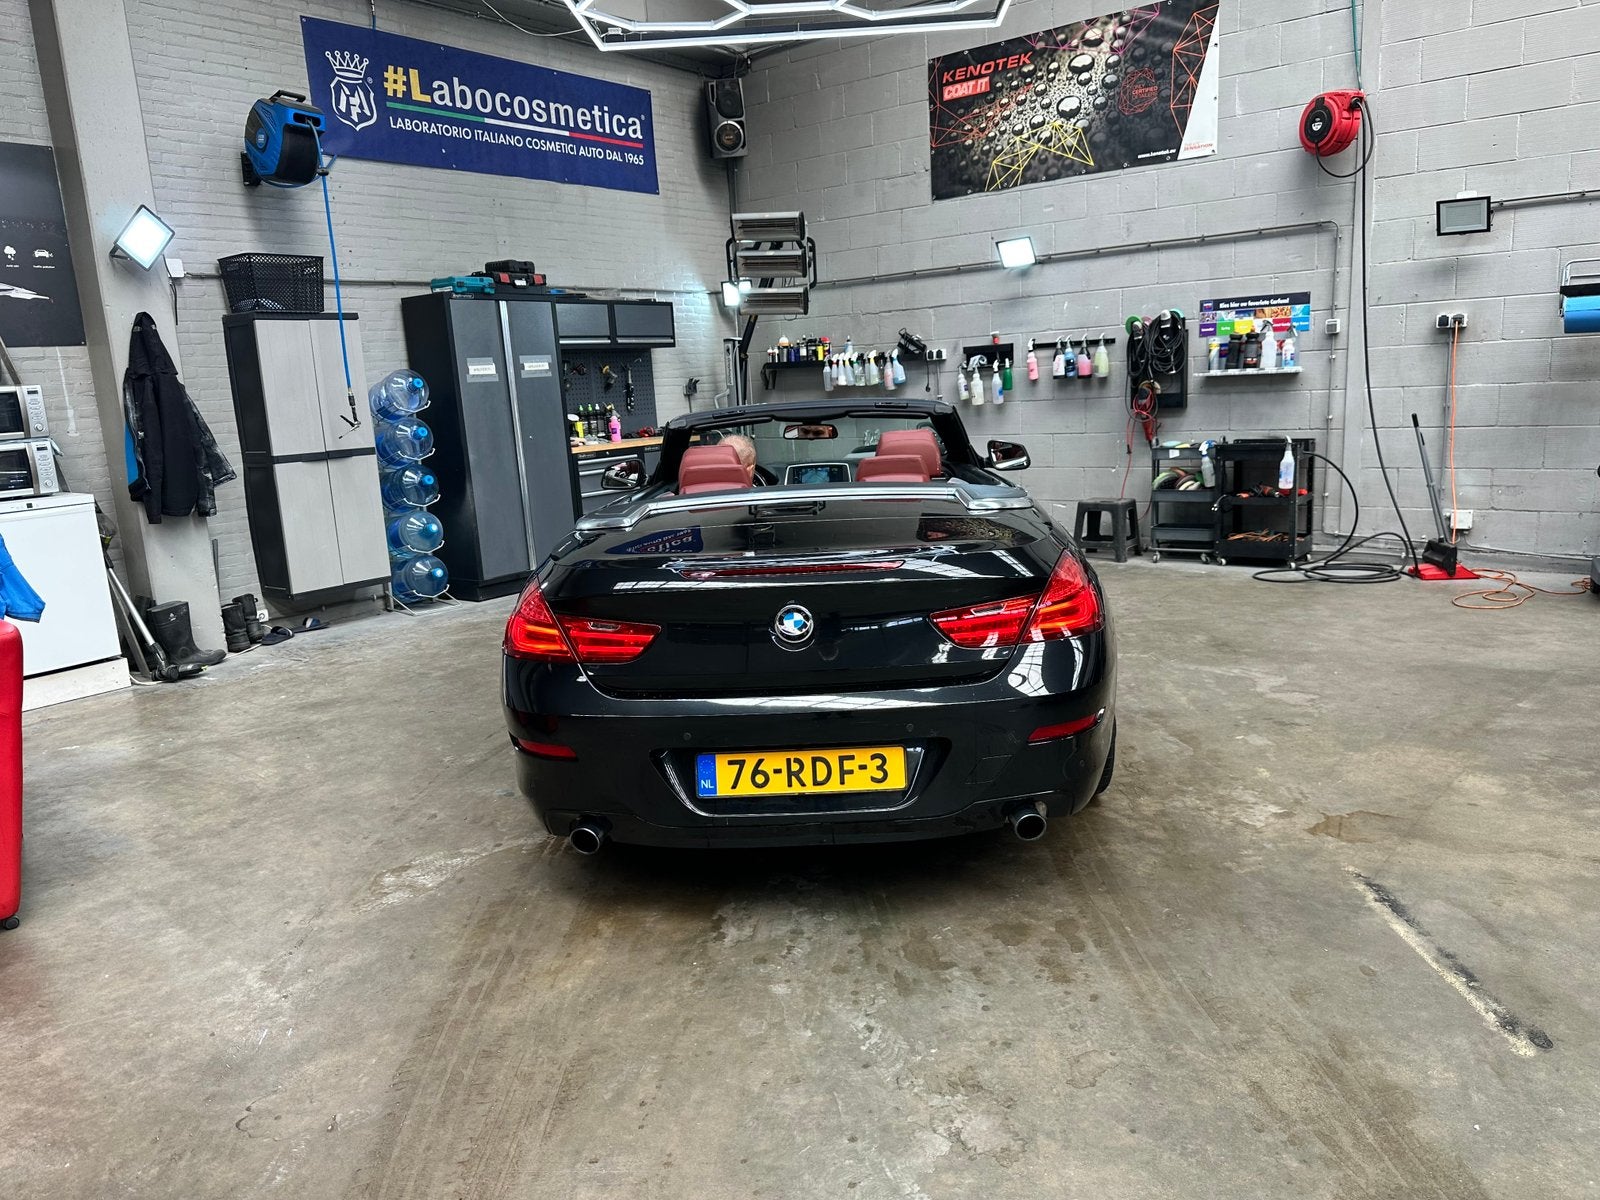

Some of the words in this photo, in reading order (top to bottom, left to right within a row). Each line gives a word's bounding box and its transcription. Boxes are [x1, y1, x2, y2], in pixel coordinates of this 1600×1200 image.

[942, 52, 1033, 84] KENOTEK
[383, 65, 645, 140] #Labocosmetica
[944, 81, 974, 98] COAT
[976, 77, 989, 94] IT
[389, 116, 472, 140] LABORATORIO
[474, 128, 523, 147] ITALIANO
[525, 137, 577, 155] COSMETICI
[578, 145, 604, 159] AUTO
[605, 149, 623, 162] DAL
[624, 152, 644, 165] 1965
[701, 780, 714, 789] NL
[727, 753, 889, 790] 76-RDF-3
